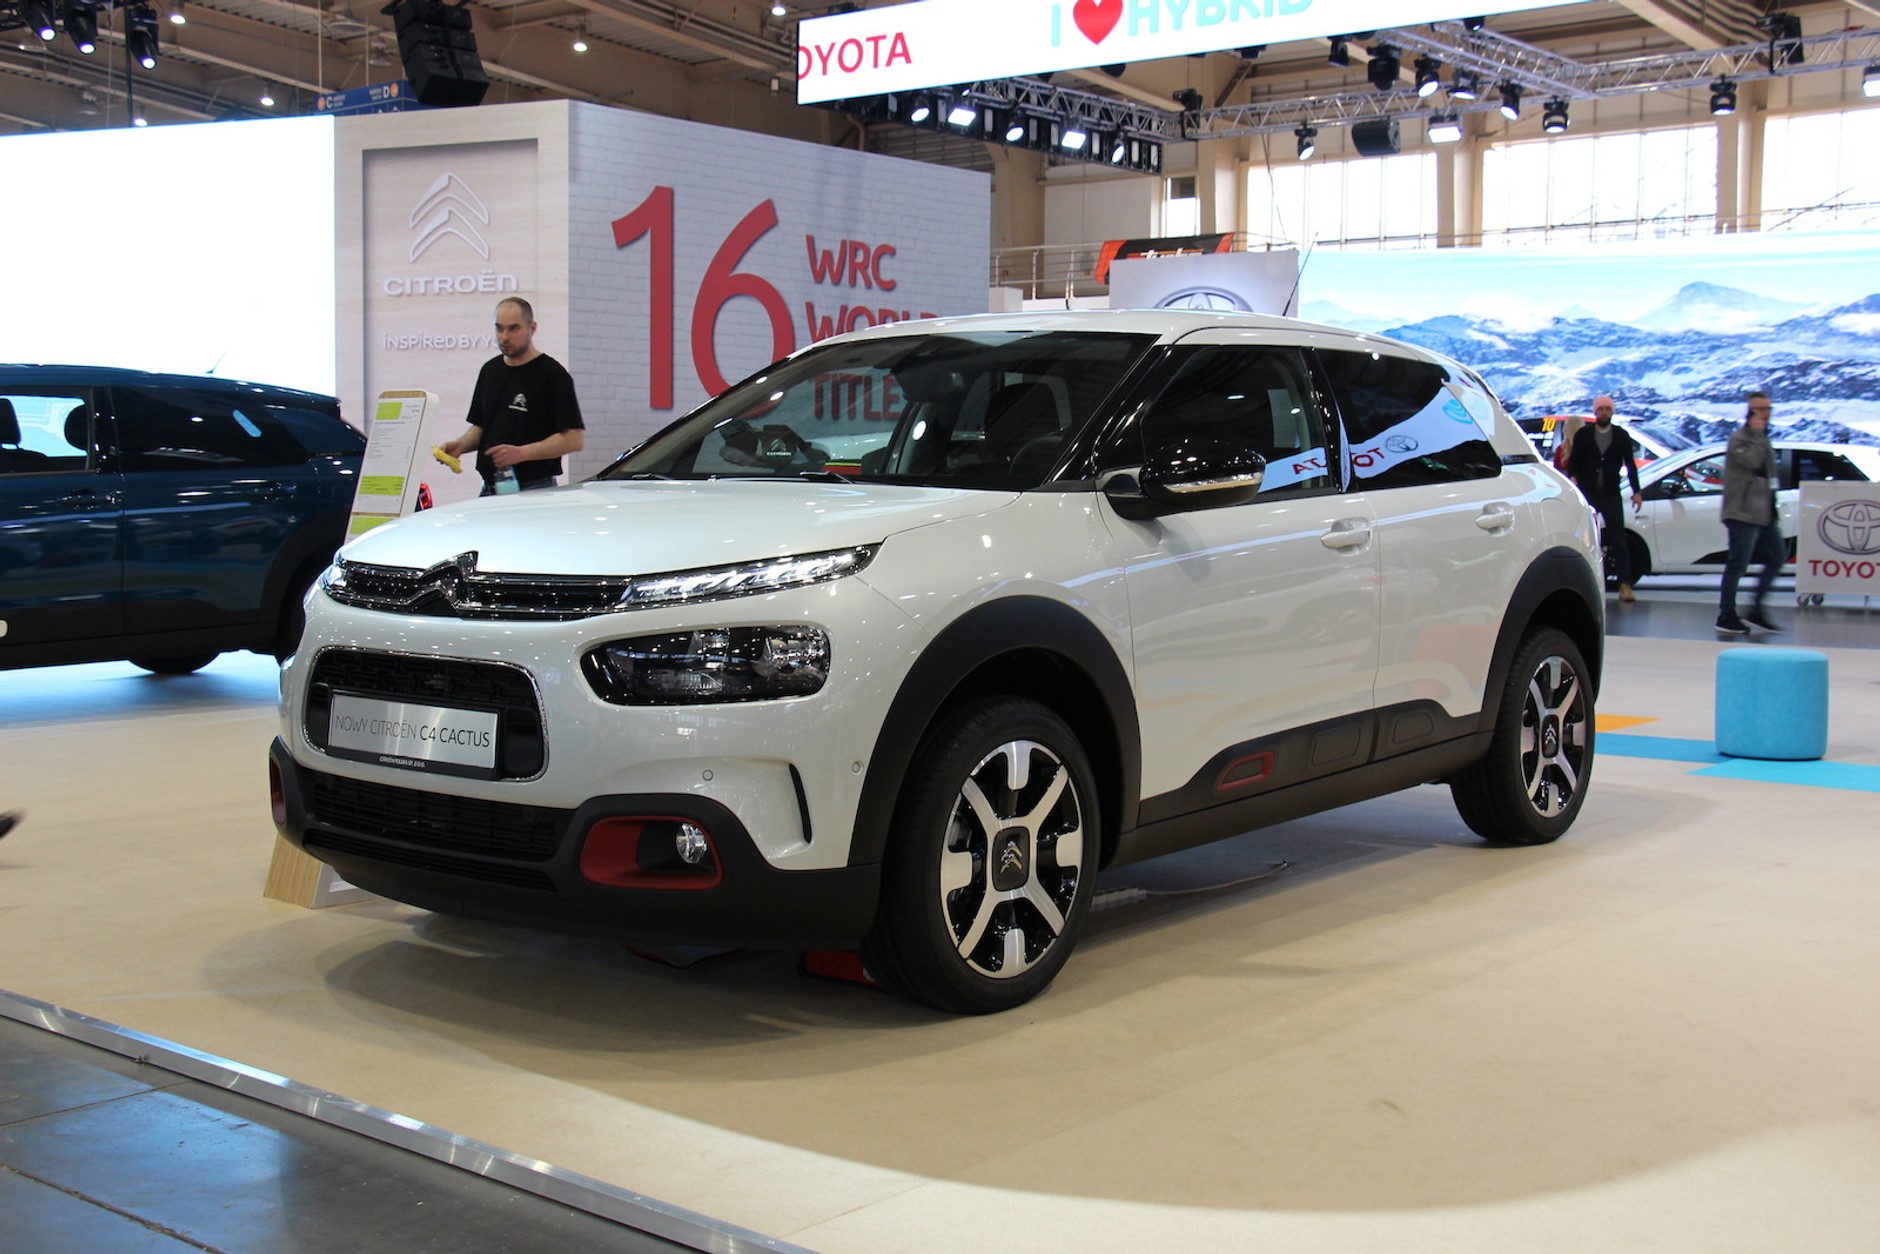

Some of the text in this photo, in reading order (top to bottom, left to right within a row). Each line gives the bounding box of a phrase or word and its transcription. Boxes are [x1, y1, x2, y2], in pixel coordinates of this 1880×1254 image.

[806, 234, 896, 291] WRC
[611, 185, 797, 410] 16
[459, 335, 481, 348] BY
[1541, 417, 1557, 432] 10
[335, 715, 369, 733] NOWY
[419, 725, 437, 742] C4
[439, 727, 490, 748] CACTUS
